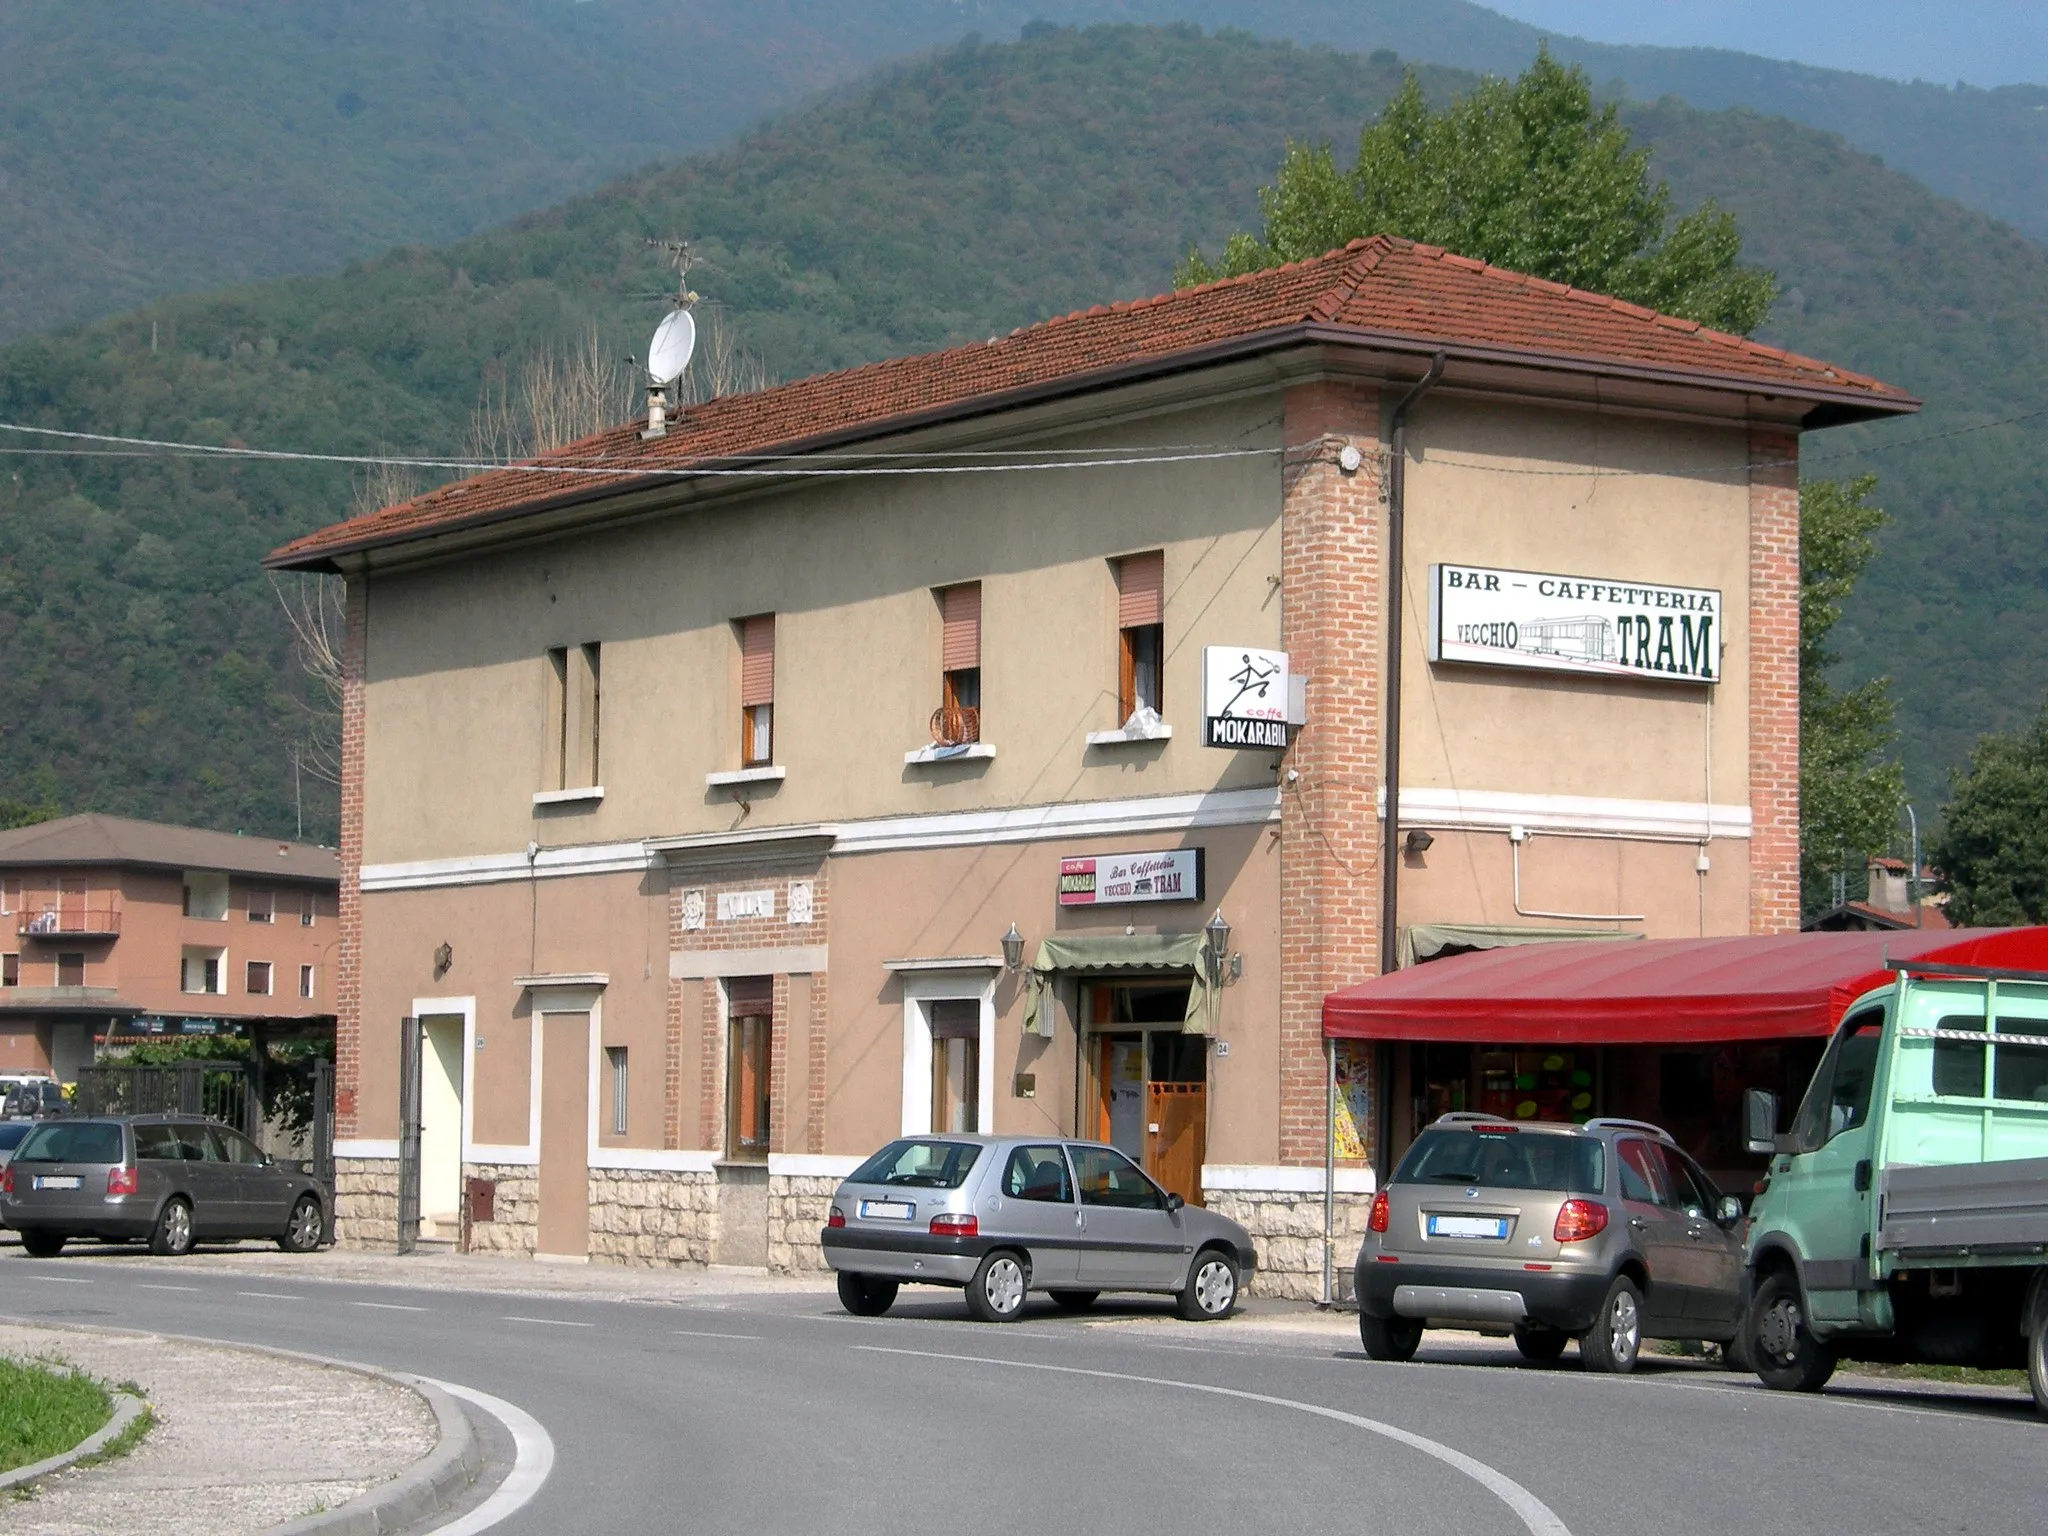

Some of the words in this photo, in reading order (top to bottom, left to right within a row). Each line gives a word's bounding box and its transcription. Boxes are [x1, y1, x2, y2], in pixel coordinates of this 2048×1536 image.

[1447, 570, 1501, 592] BAR
[1539, 580, 1714, 612] CAFFETTERIA
[1457, 621, 1518, 649] VECCHIO
[1617, 615, 1713, 678] TRAM
[1213, 719, 1286, 747] MOKARABIA
[1109, 865, 1127, 880] Bar
[1130, 857, 1175, 877] Caffetteria
[1104, 882, 1131, 896] VECCHIO
[1153, 872, 1181, 894] TRAM
[1218, 1044, 1228, 1054] 24
